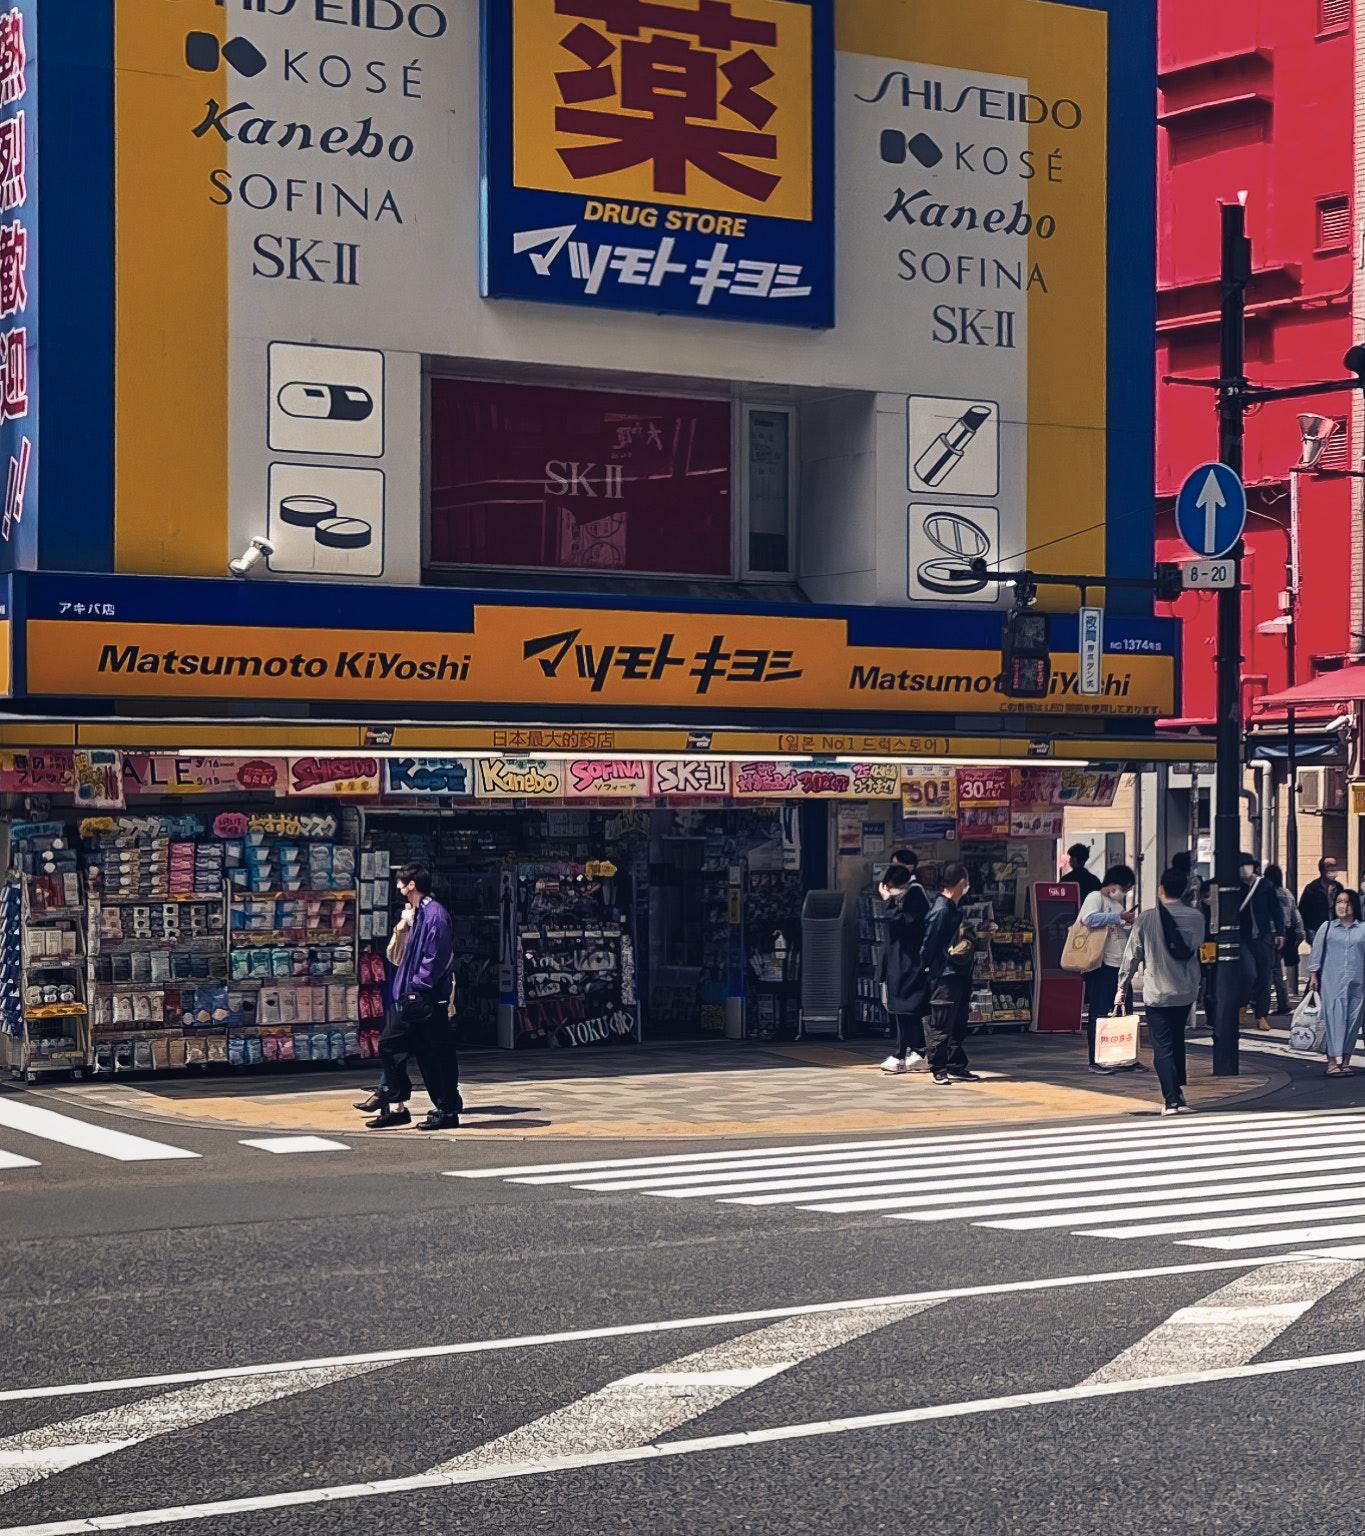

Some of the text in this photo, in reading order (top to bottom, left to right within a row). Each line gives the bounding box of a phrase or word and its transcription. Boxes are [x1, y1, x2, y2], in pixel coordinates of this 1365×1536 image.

[283, 47, 425, 100] KOSÉ
[854, 70, 1083, 131] SHISEIDO
[191, 97, 416, 164] Kanebo
[955, 146, 1064, 183] KOSÉ
[208, 168, 405, 225] SOFINA
[583, 200, 748, 238] DRUG STORE
[883, 187, 1058, 240] Kanebo
[512, 224, 813, 305] マツモトキヨシ
[897, 248, 1049, 294] SOFINA
[58, 601, 116, 617] アキバ店
[97, 644, 472, 682] Matsumoto KiYoshi
[522, 627, 802, 695] マツモトキヨシ
[848, 665, 1004, 696] Matsumot
[121, 757, 194, 785] ALE
[480, 758, 559, 793] Kanebo
